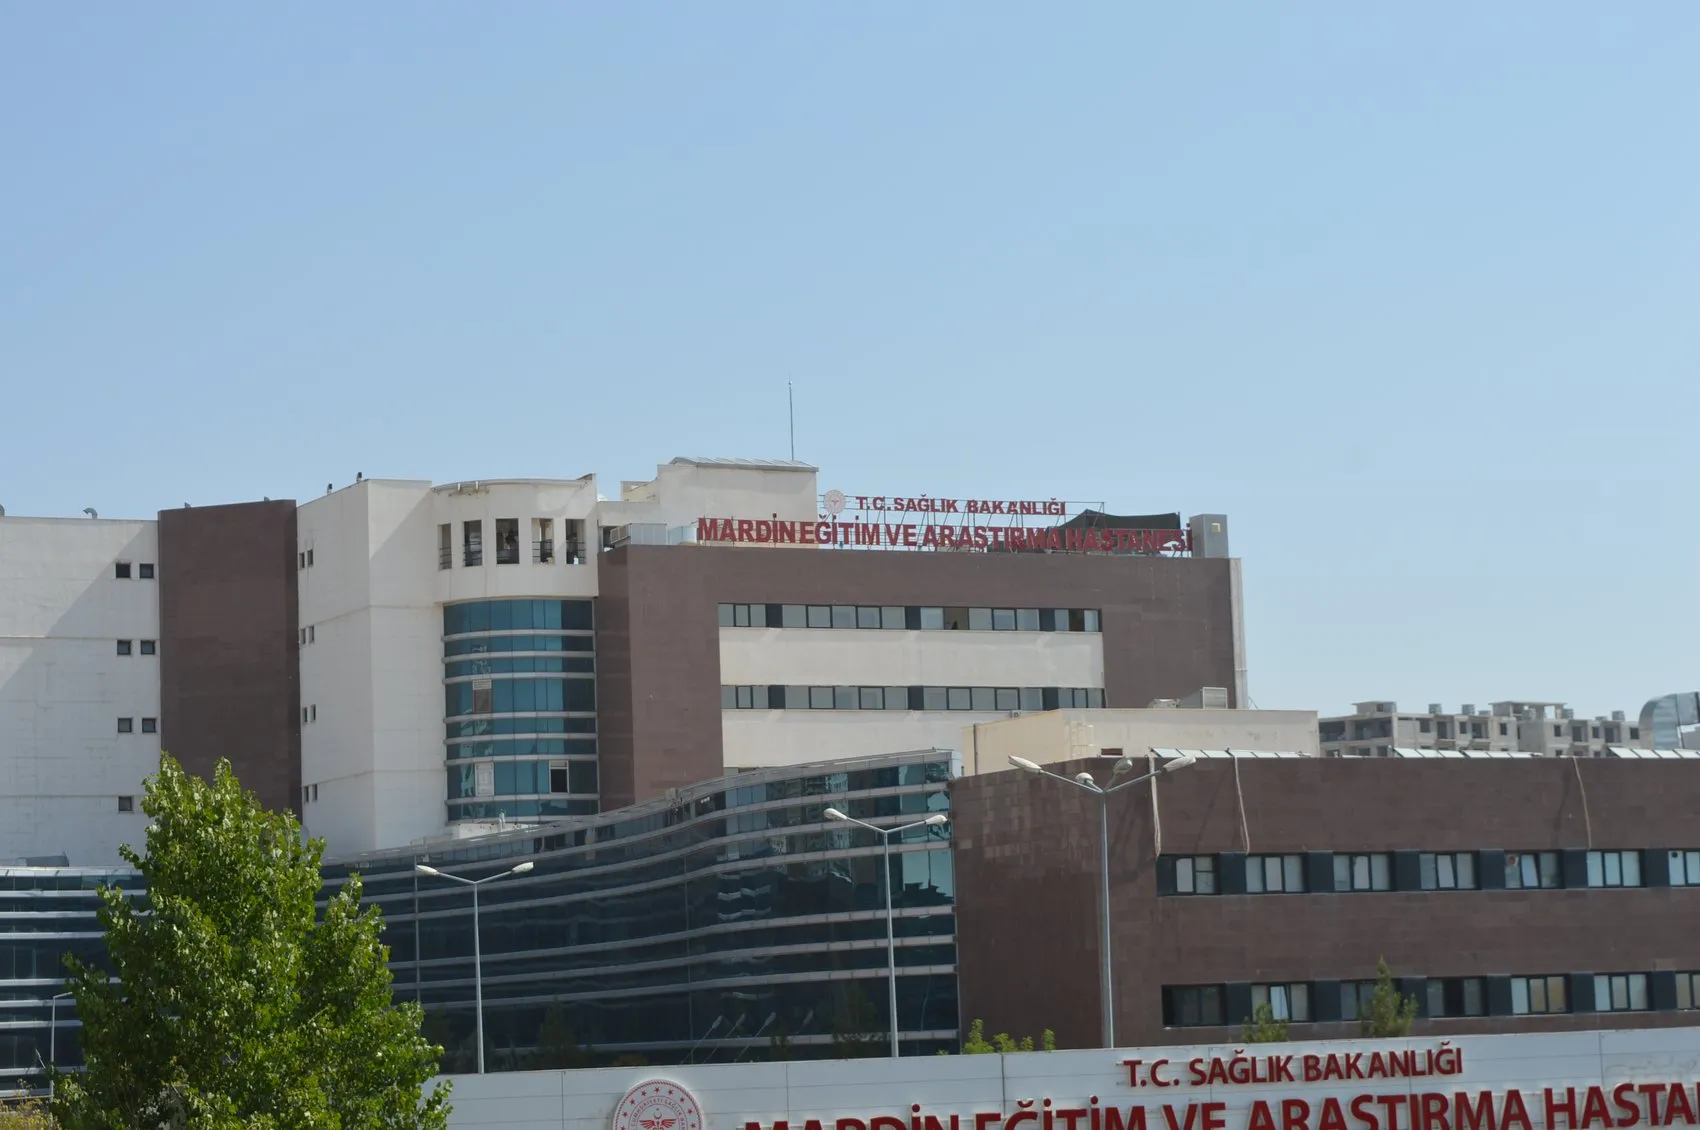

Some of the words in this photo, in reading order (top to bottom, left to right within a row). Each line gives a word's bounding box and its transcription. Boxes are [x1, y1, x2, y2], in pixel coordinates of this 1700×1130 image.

[856, 496, 891, 511] T.C.
[893, 494, 958, 513] SAĞLIK
[967, 497, 1066, 516] BAKANLIĞI
[697, 513, 796, 544] MARDİN
[801, 514, 880, 545] EĞİTİM
[885, 523, 917, 547] VE
[1065, 523, 1193, 552] HASTANESİ
[1123, 1059, 1180, 1087] T.C.
[1189, 1049, 1295, 1086] SAĞLIK
[1303, 1040, 1463, 1082] BAKANLIĞI
[1163, 1102, 1227, 1130] VE
[1544, 1082, 1700, 1130] HASTA
